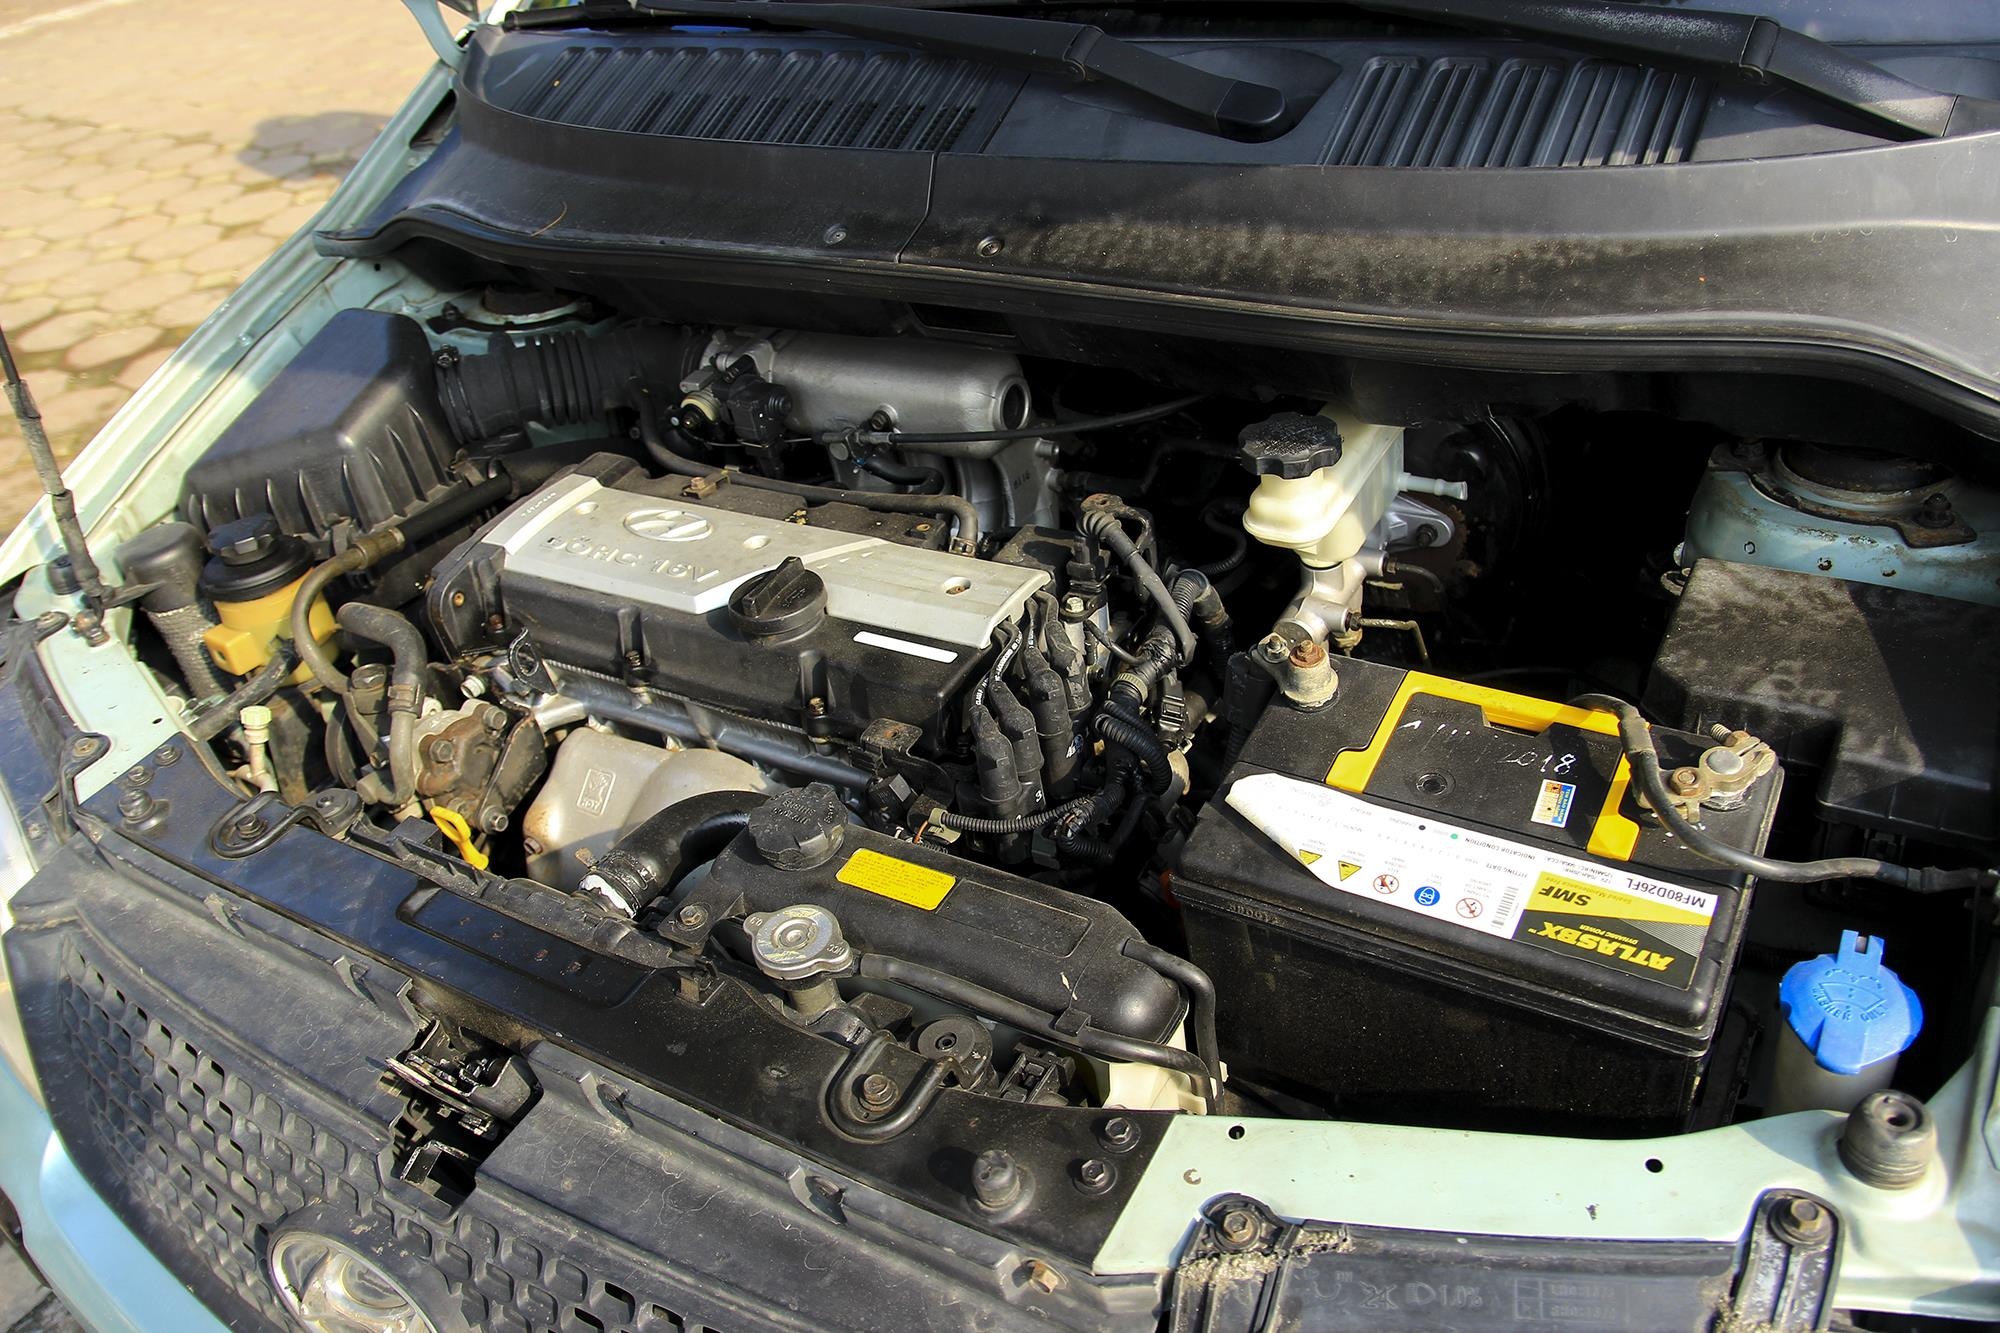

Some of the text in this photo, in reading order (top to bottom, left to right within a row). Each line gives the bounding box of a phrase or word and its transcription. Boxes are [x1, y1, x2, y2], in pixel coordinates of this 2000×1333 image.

[782, 799, 816, 816] ENGINE
[1539, 886, 1591, 907] SMF
[1624, 877, 1706, 909] MF80D26FL
[1579, 924, 1638, 945] DYNAMIC POWER
[826, 943, 845, 956] HCC
[1538, 921, 1674, 971] ATLASBX
